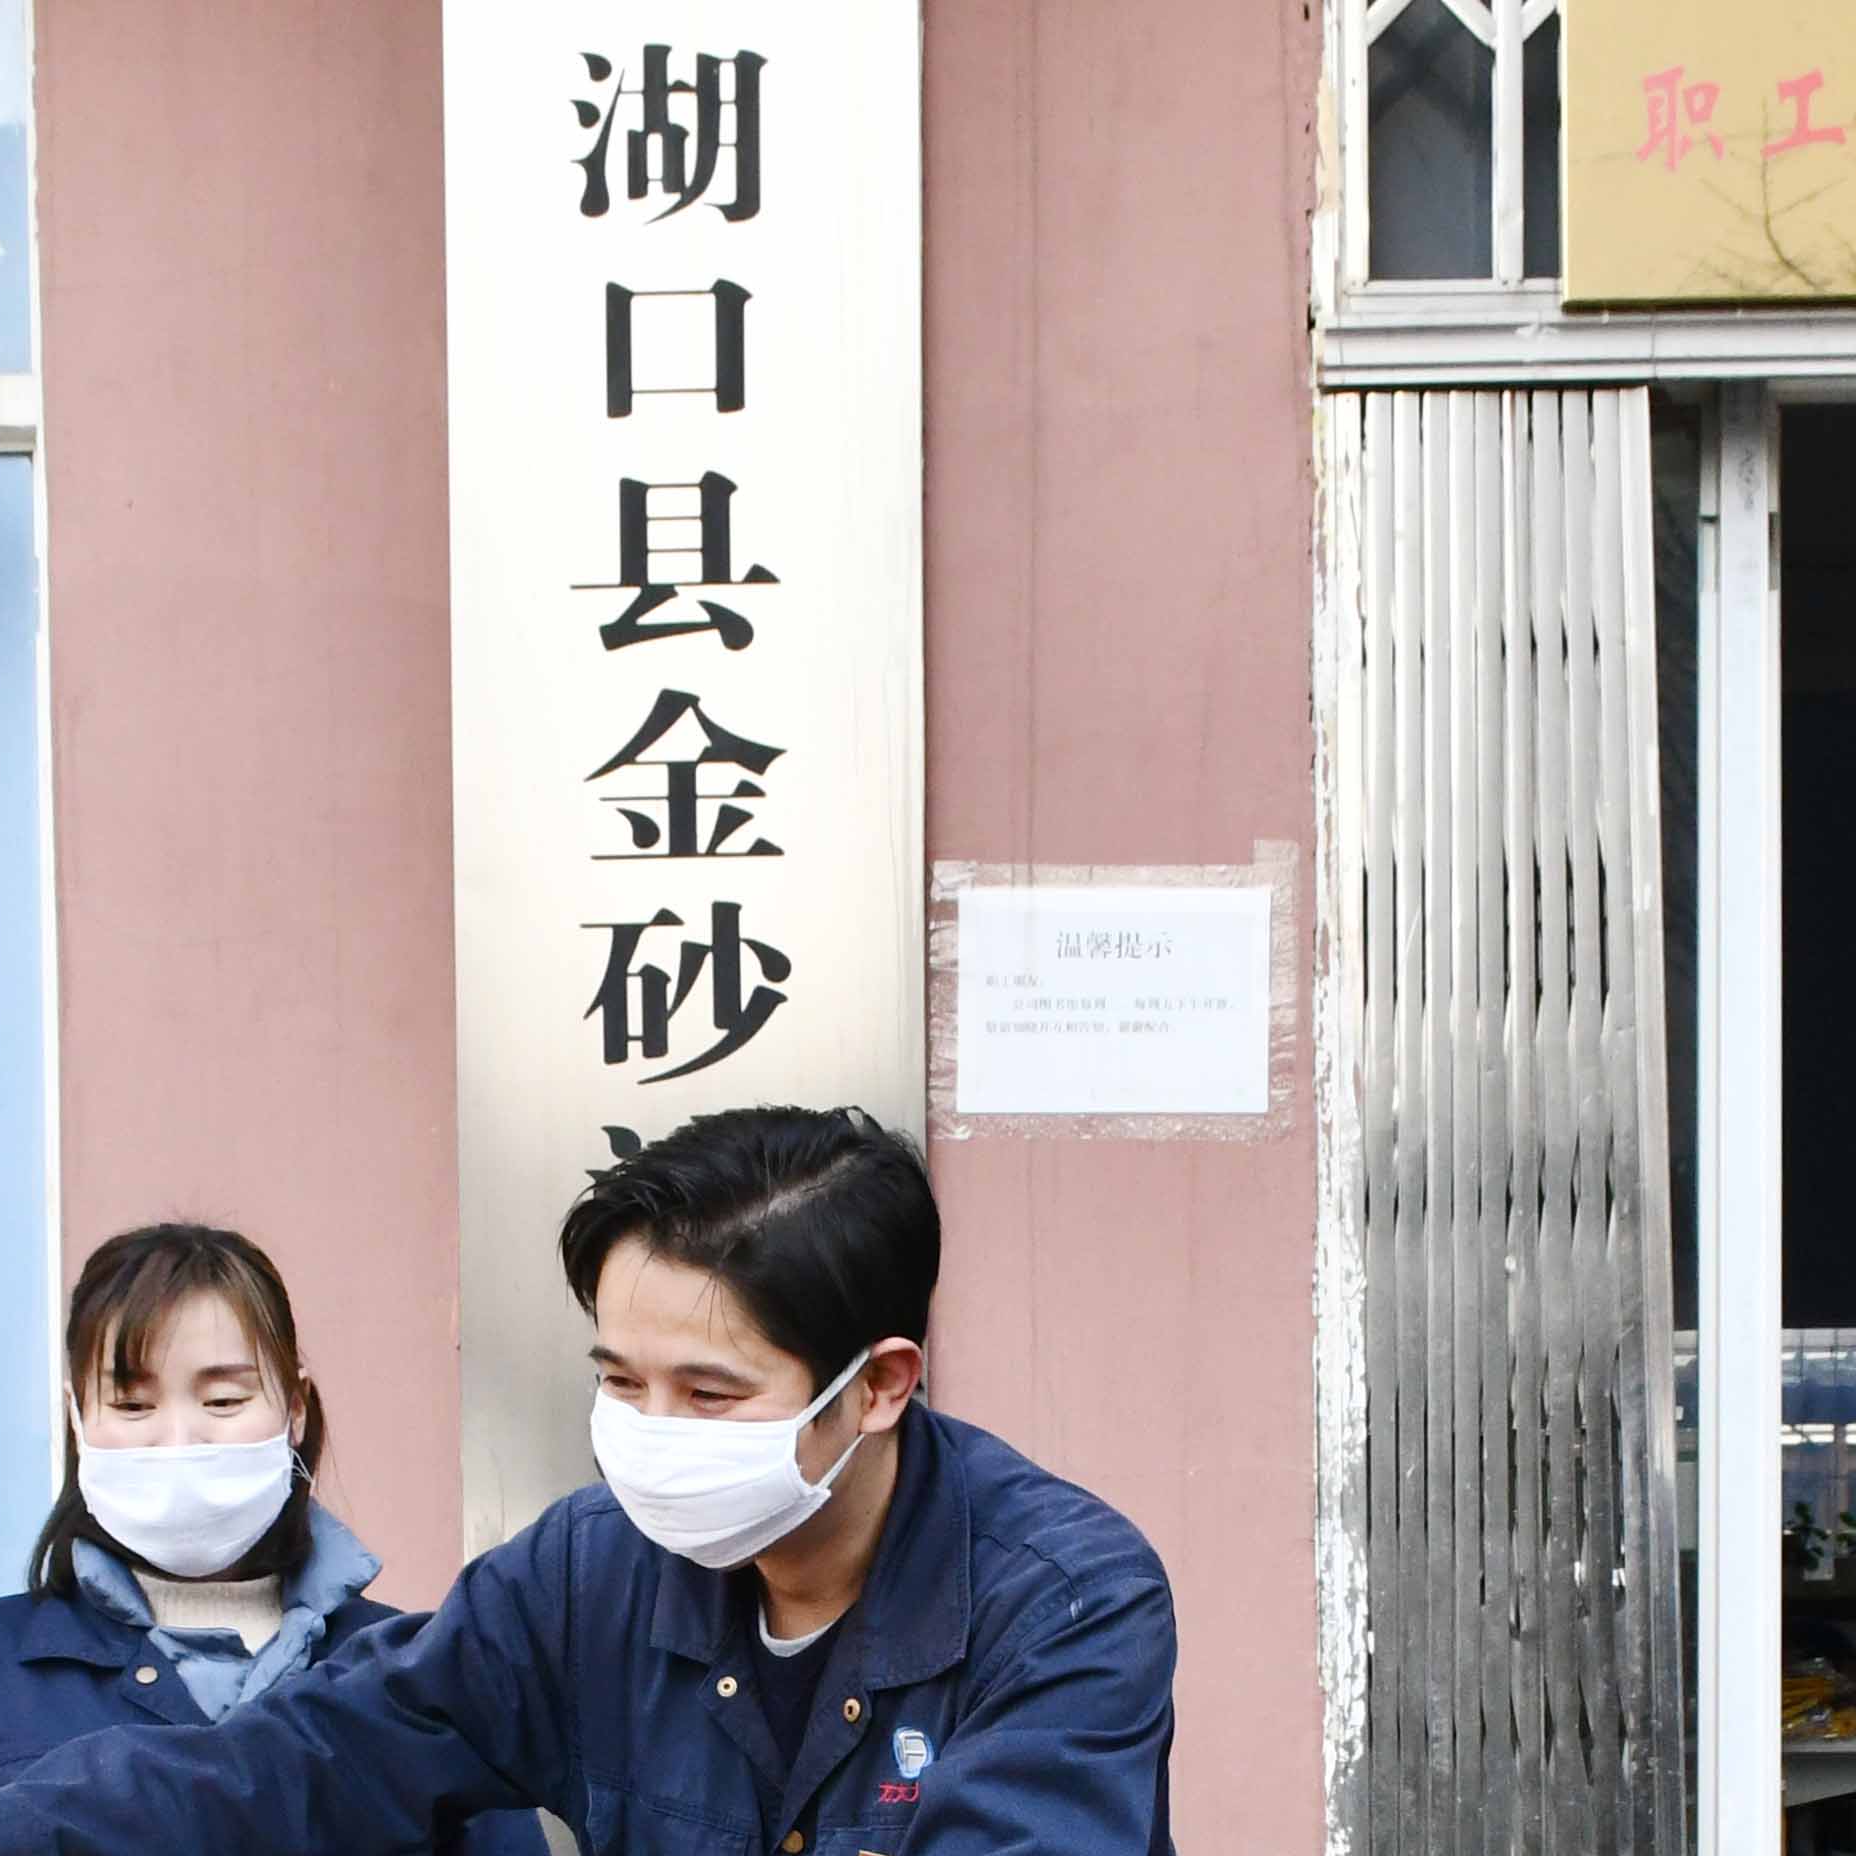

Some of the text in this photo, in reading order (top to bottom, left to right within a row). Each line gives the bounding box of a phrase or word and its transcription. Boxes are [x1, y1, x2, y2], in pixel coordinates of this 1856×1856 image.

[570, 44, 792, 1182] 湖口县金砂
[1056, 932, 1174, 960] 温馨提示
